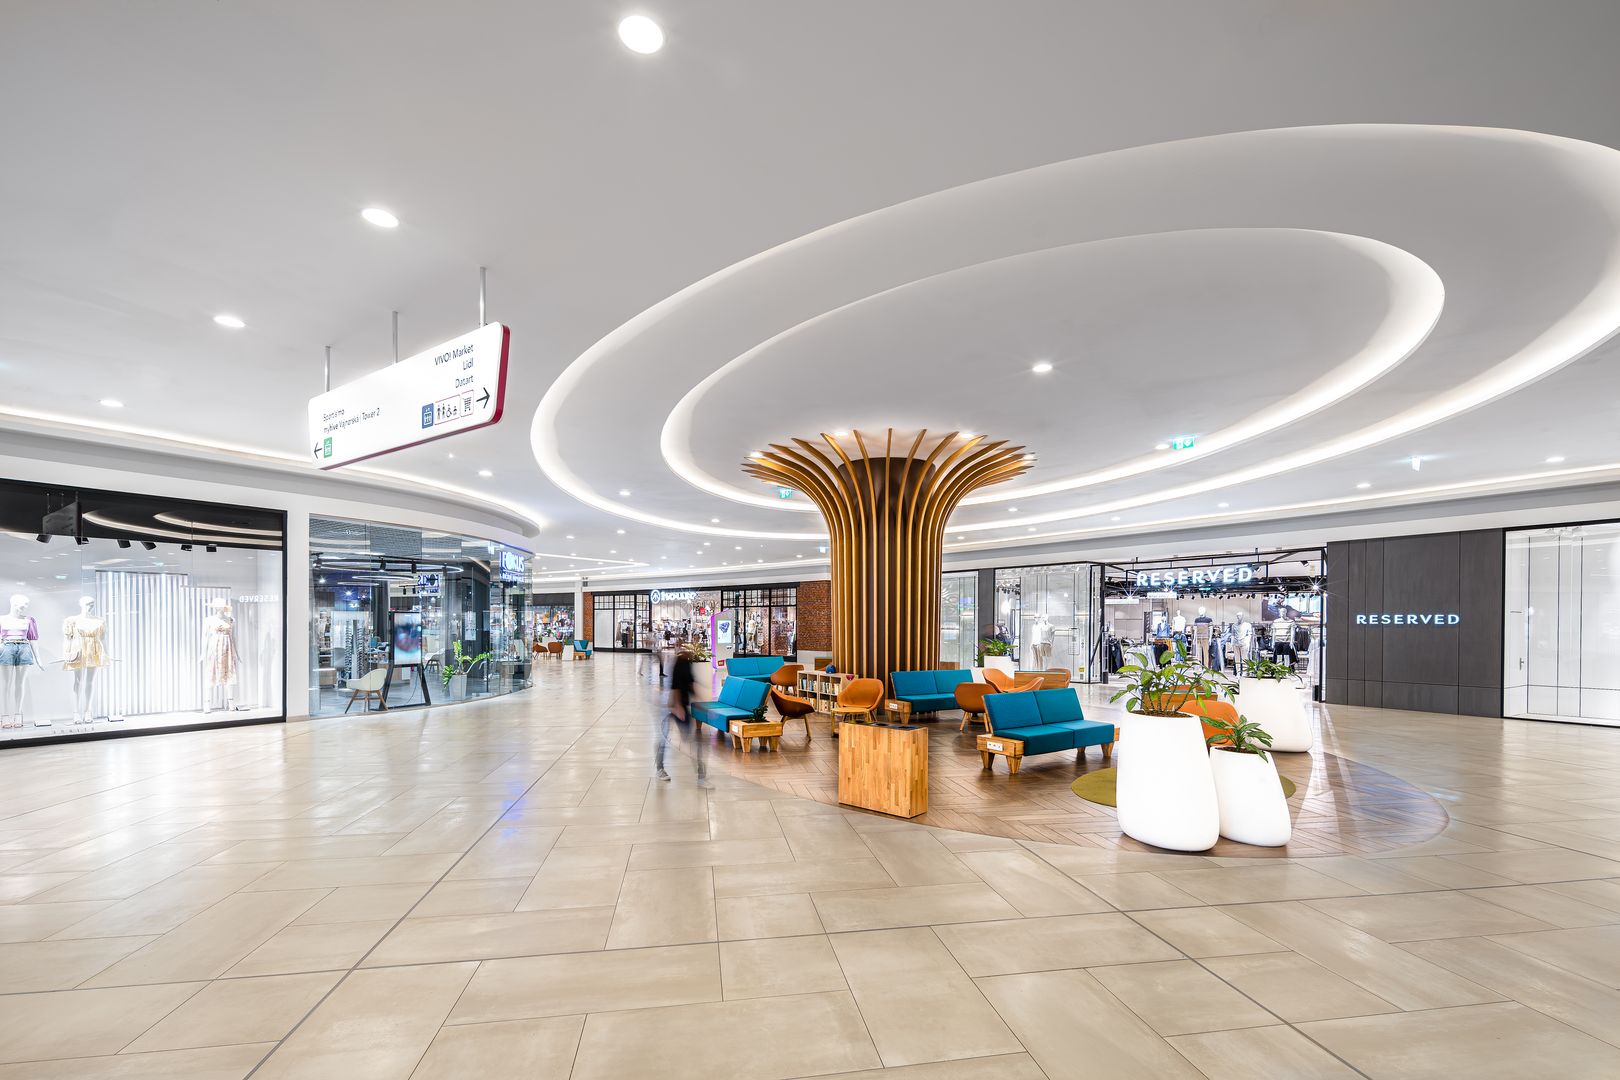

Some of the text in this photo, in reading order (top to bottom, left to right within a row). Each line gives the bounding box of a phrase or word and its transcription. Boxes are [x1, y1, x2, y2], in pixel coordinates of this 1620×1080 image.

[434, 345, 474, 366] VIVO! Market
[463, 357, 474, 370] Lidl
[1136, 567, 1254, 587] RESERVED
[1355, 614, 1460, 625] RESERVED
